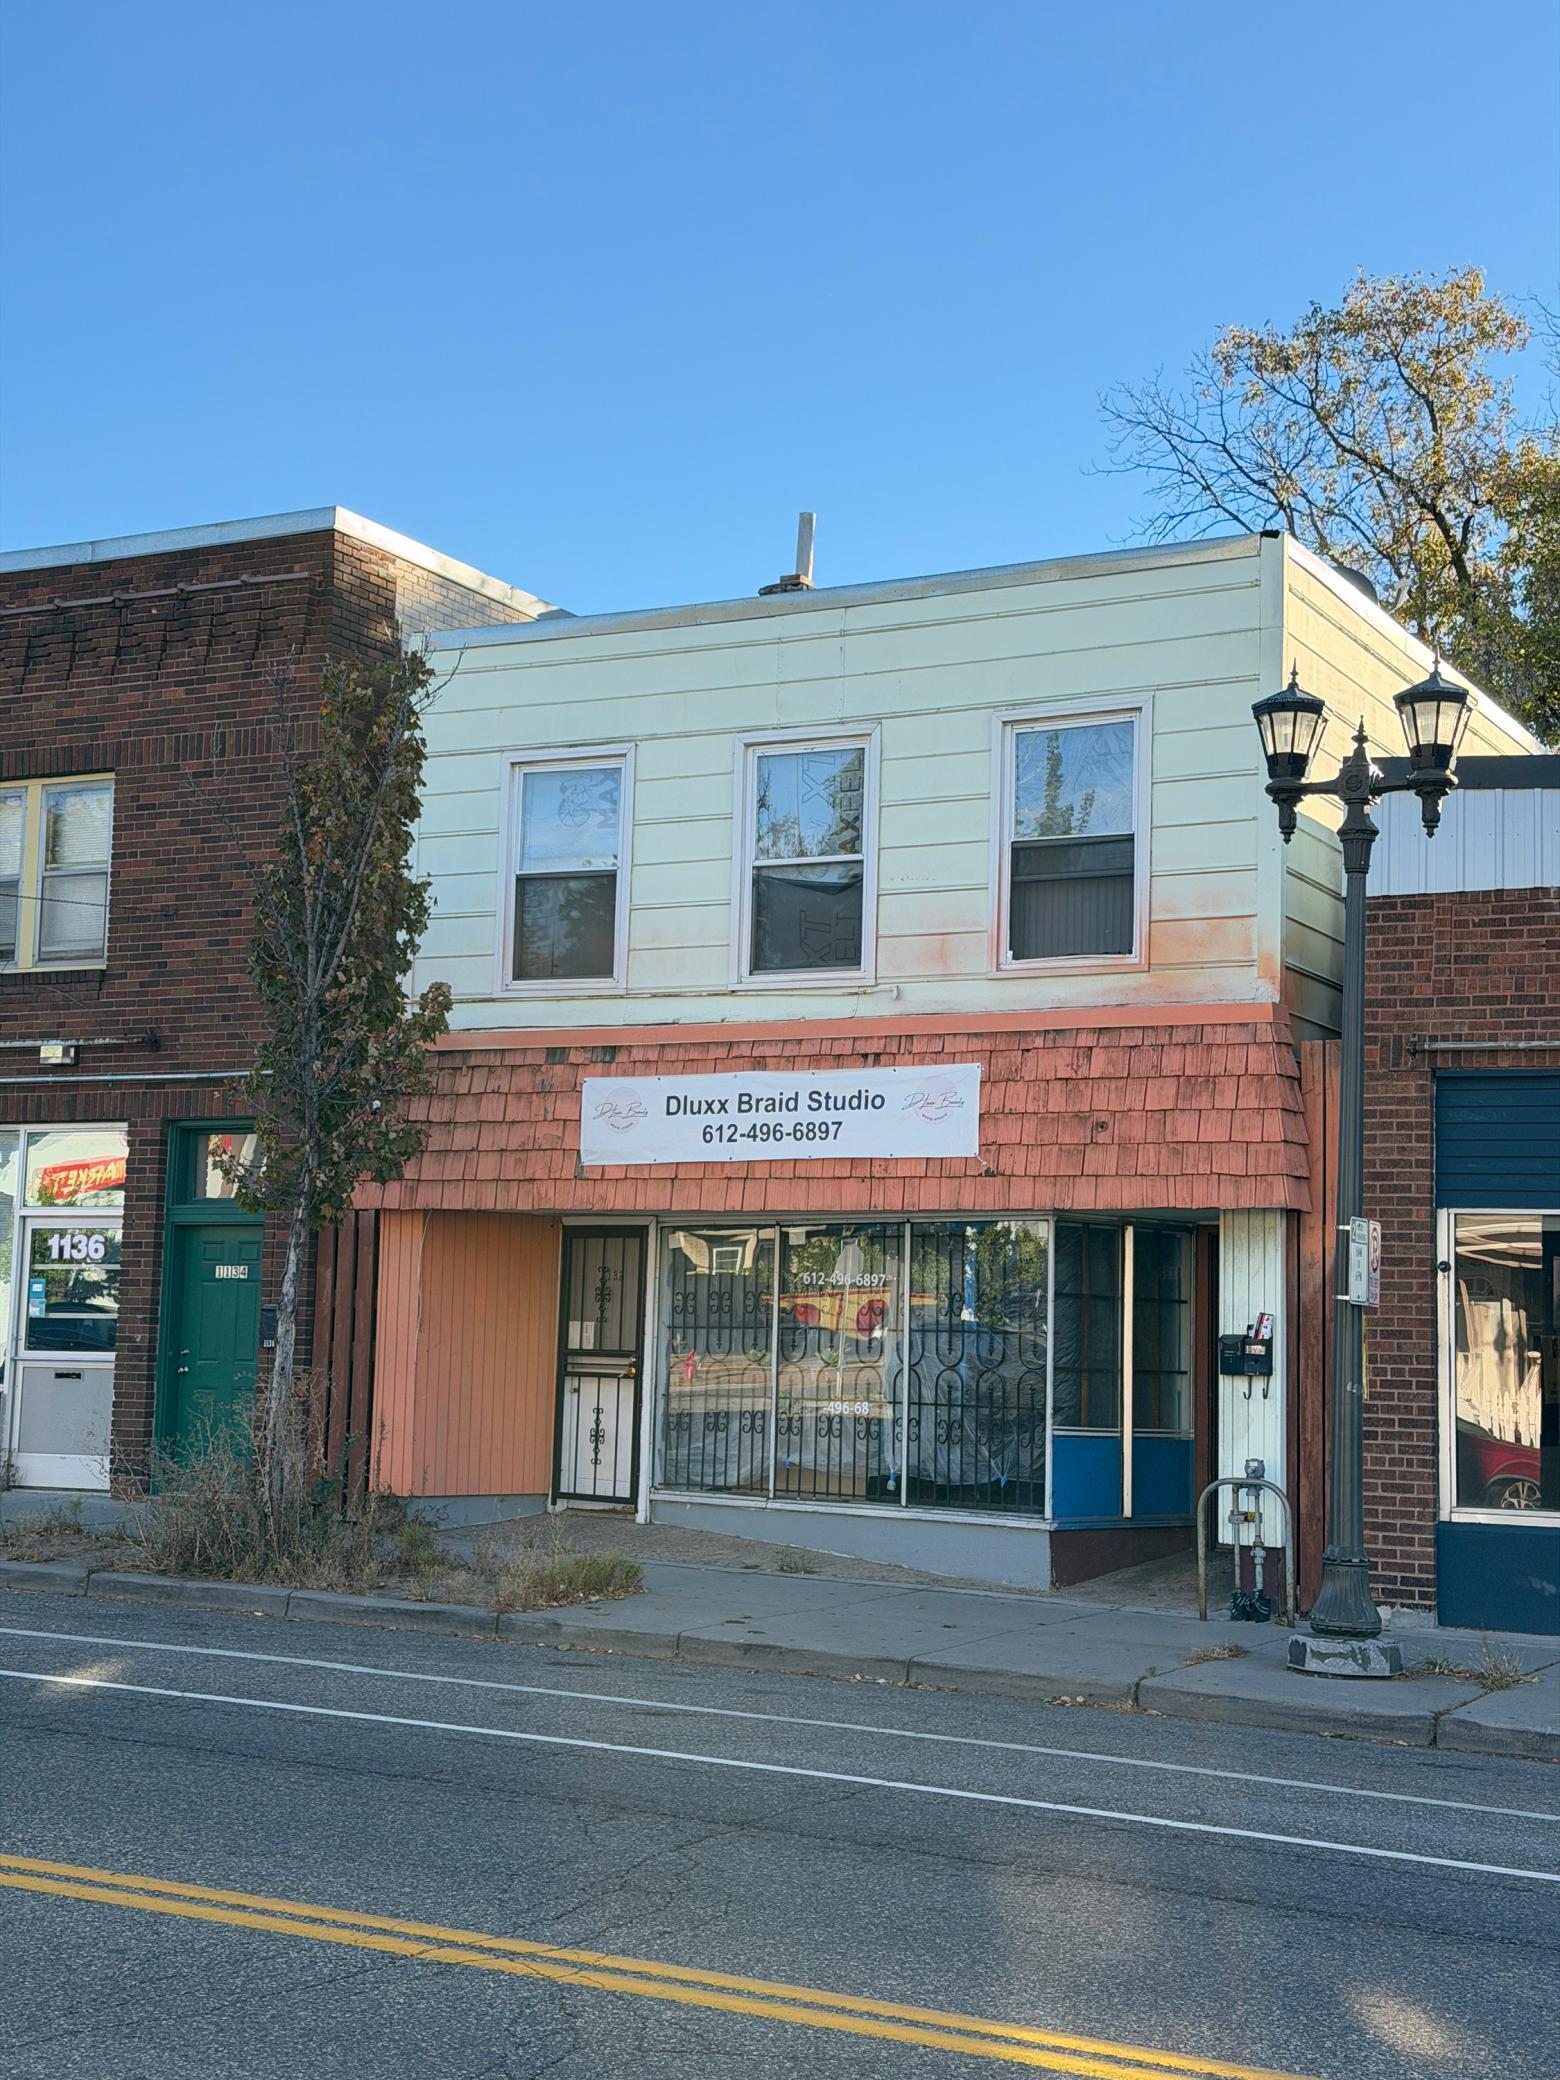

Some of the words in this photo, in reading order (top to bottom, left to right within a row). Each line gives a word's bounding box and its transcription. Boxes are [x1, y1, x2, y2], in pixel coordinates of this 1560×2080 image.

[665, 1095, 730, 1116] Dluxx
[737, 1091, 799, 1114] Braid
[807, 1089, 886, 1112] Studio
[702, 1121, 843, 1144] 612-496-6897
[48, 1233, 106, 1260] 1136
[216, 1266, 248, 1278] 1134
[803, 1271, 885, 1287] 612-496-6897
[823, 1402, 869, 1415] -496-68
